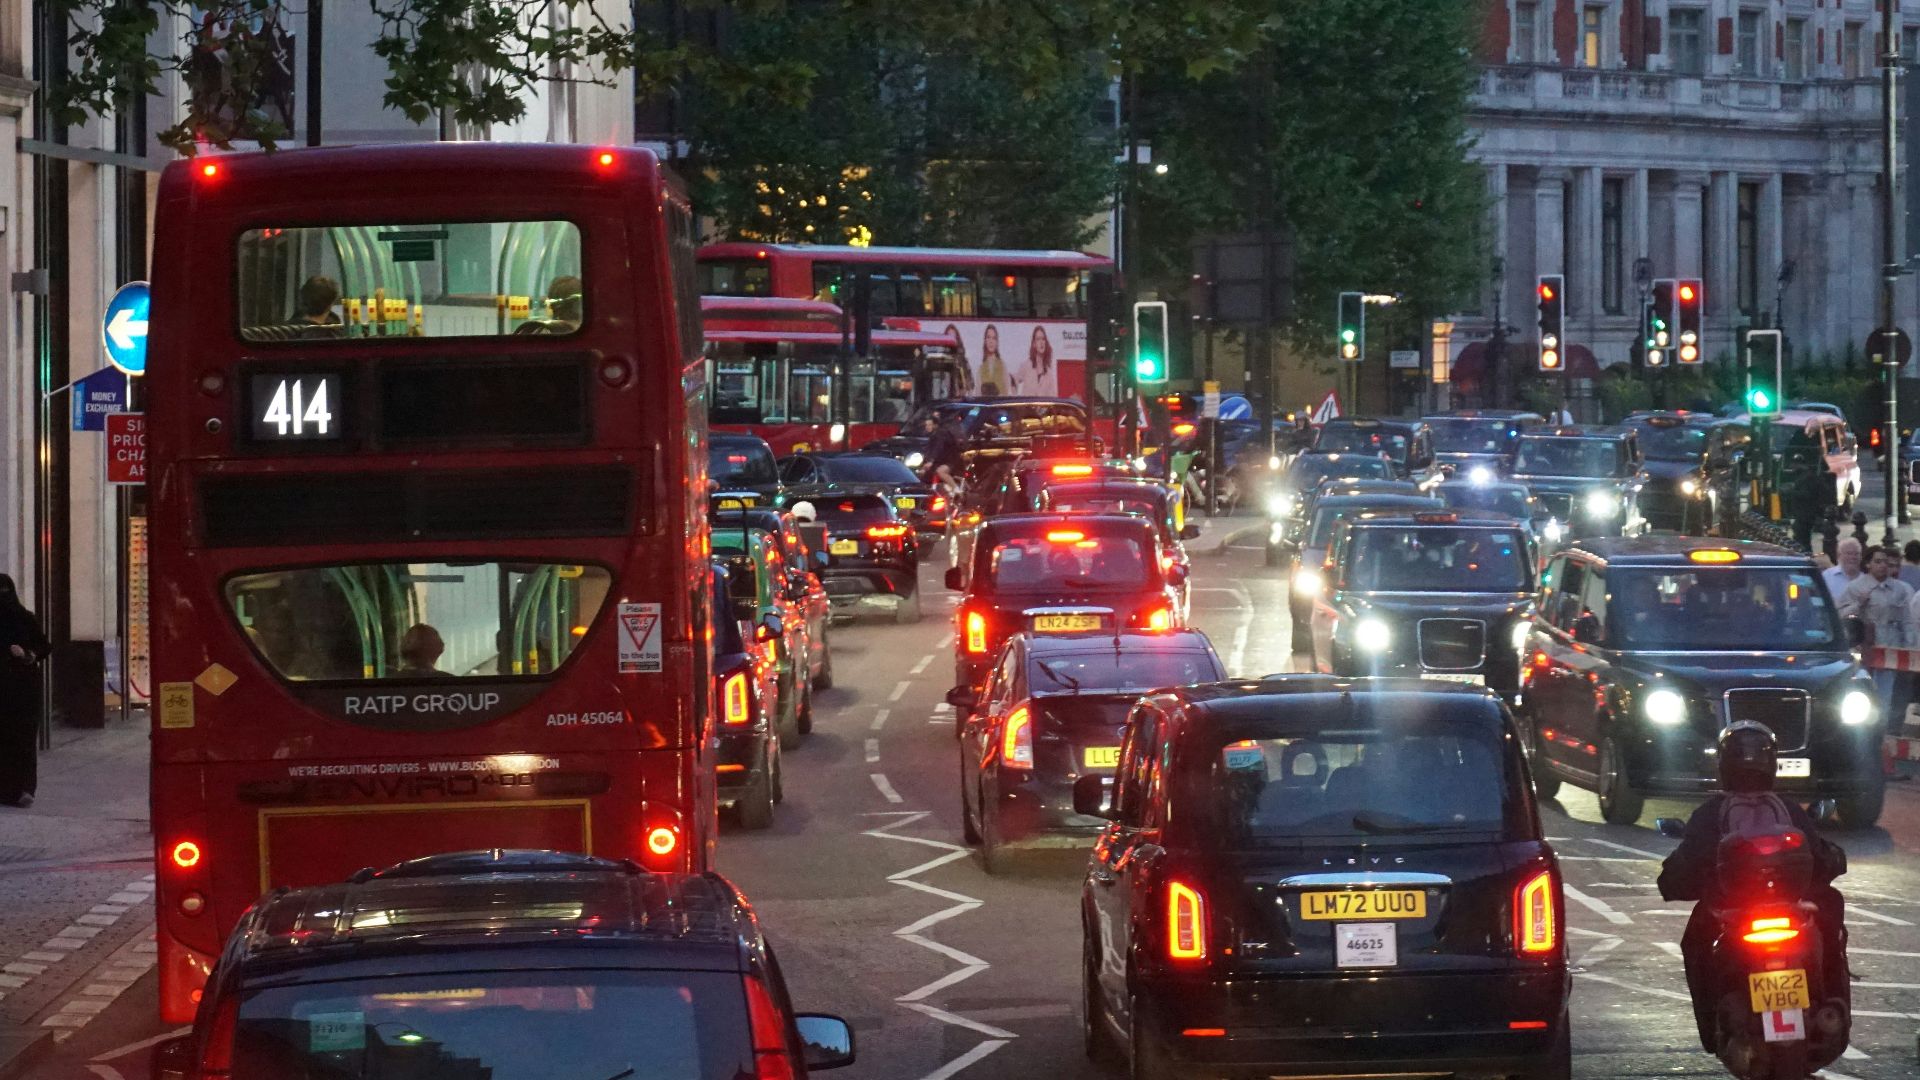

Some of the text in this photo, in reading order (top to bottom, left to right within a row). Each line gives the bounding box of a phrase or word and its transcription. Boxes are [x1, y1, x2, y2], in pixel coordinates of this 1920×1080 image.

[91, 391, 117, 401] MONEY
[85, 403, 122, 413] EXCHANGE
[263, 379, 332, 435] 414
[345, 692, 499, 714] RATP GROUP
[546, 711, 624, 727] ADH 45064
[288, 766, 319, 777] WE'RE
[320, 764, 378, 775] RECRUITING
[379, 763, 420, 774] DRIVERS
[1310, 892, 1417, 915] LM72 UUO
[1346, 938, 1384, 950] 46625
[1753, 974, 1804, 992] KN22
[1762, 991, 1800, 1007] VBG
[1772, 1011, 1796, 1033] L
